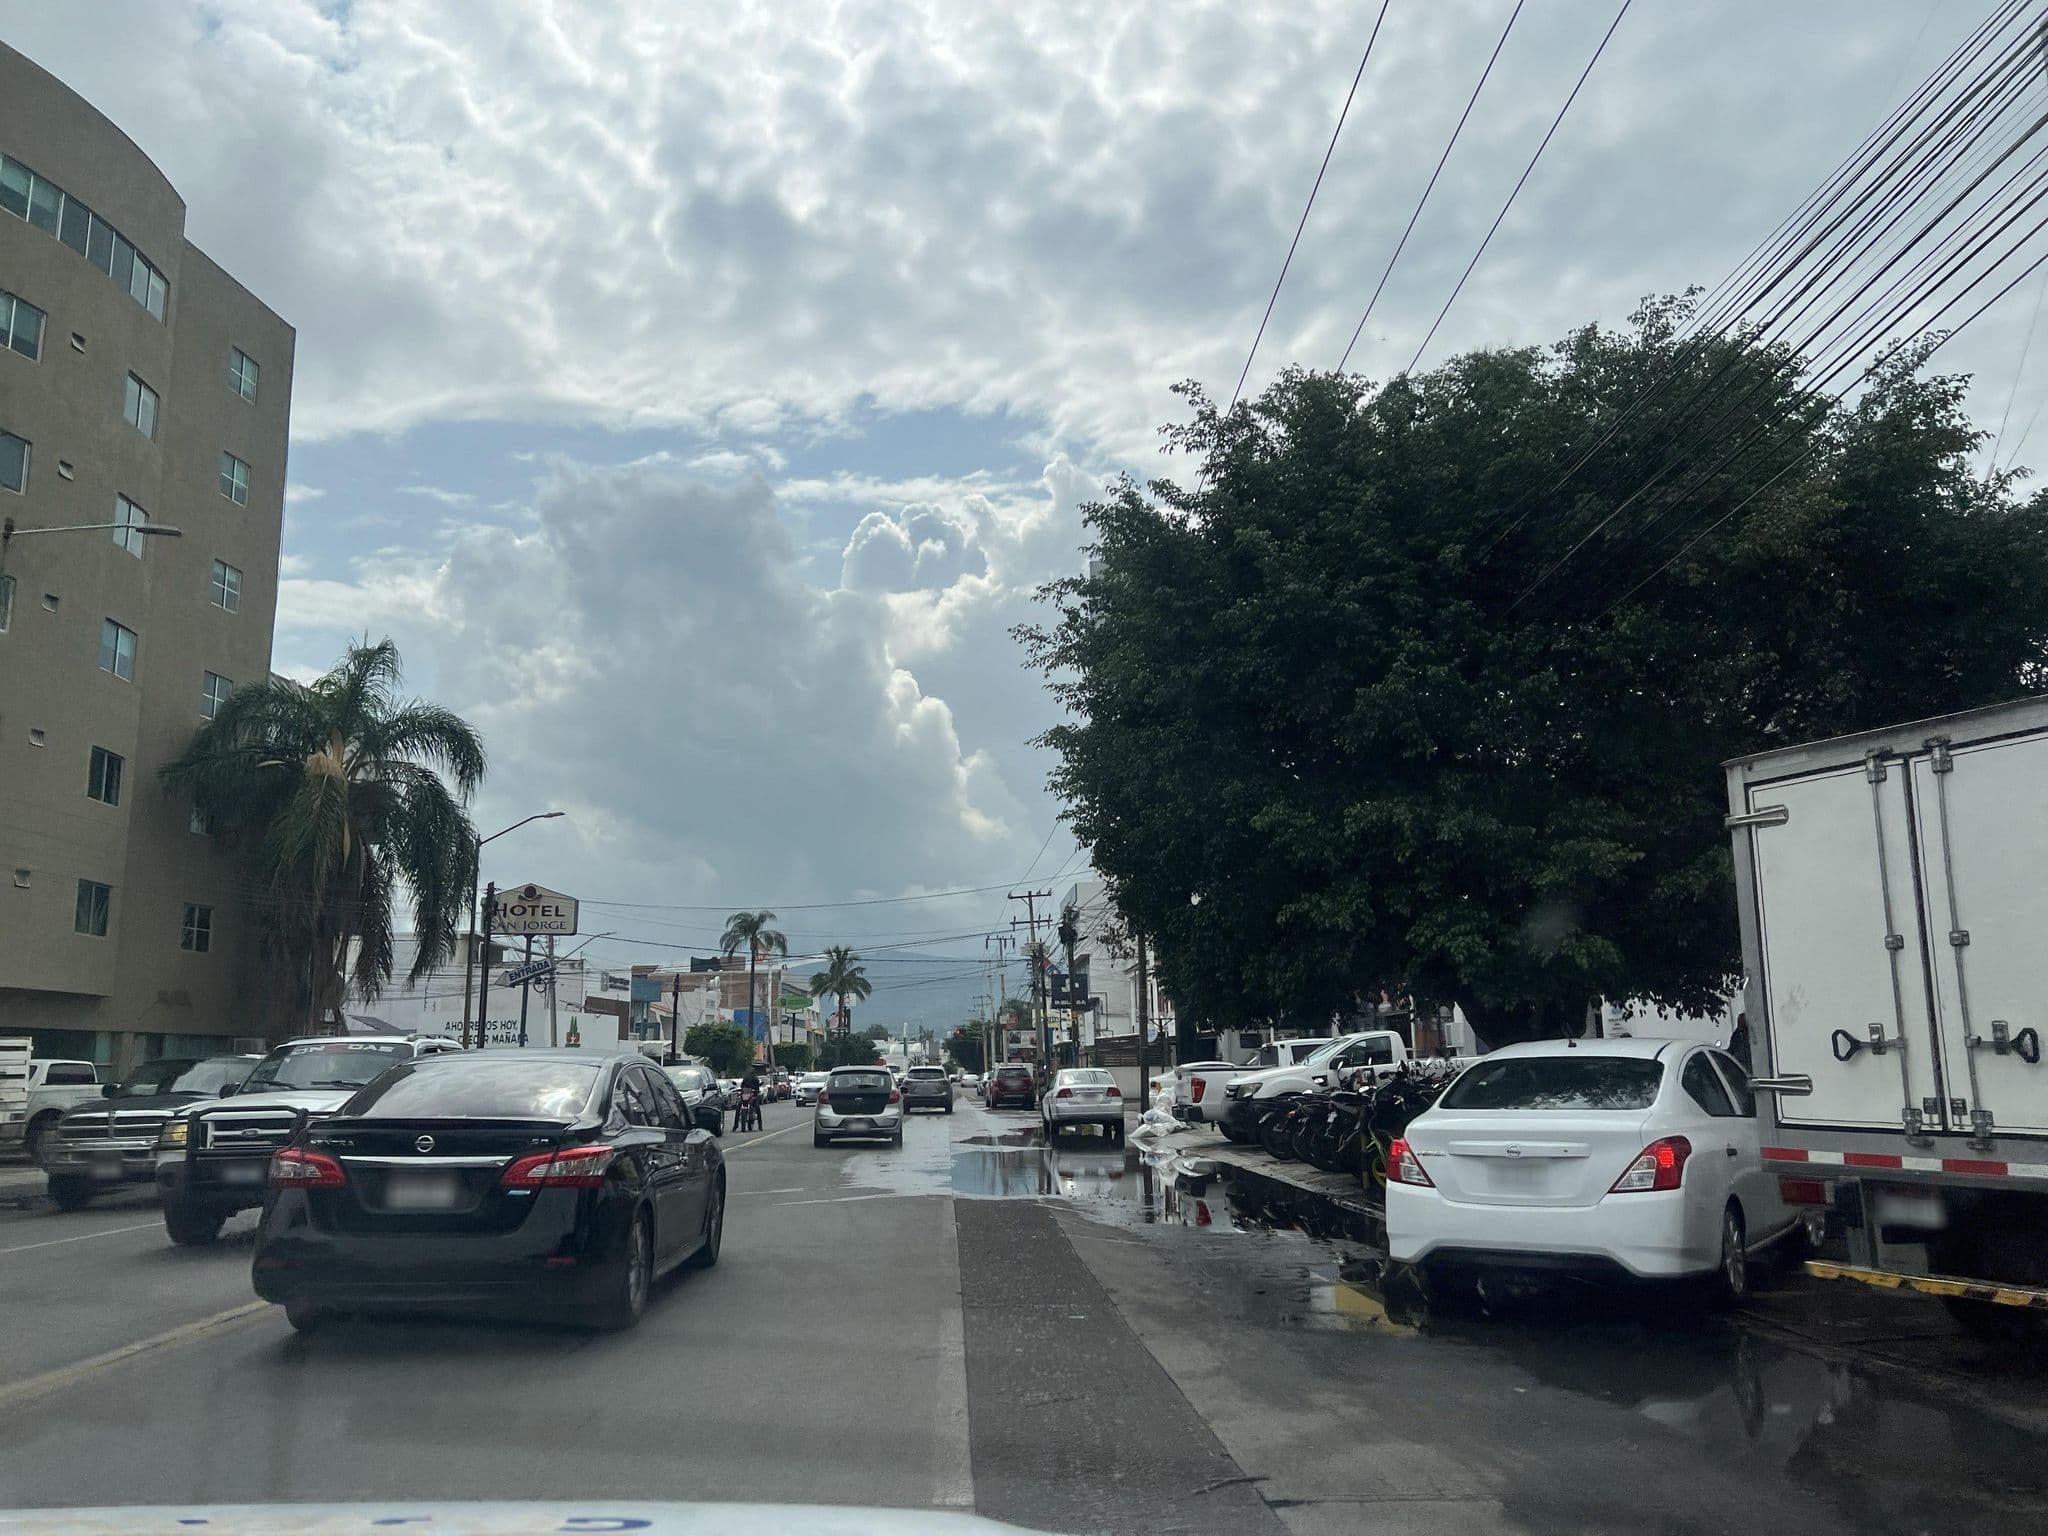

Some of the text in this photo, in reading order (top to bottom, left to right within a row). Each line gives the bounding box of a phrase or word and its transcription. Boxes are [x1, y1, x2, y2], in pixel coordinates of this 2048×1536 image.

[495, 903, 565, 918] HOTEL
[490, 920, 567, 931] SAN JORGE
[509, 960, 550, 981] ENTRADA
[445, 1021, 498, 1031] AHOREOS
[458, 1031, 528, 1045] CECR MAÑAA
